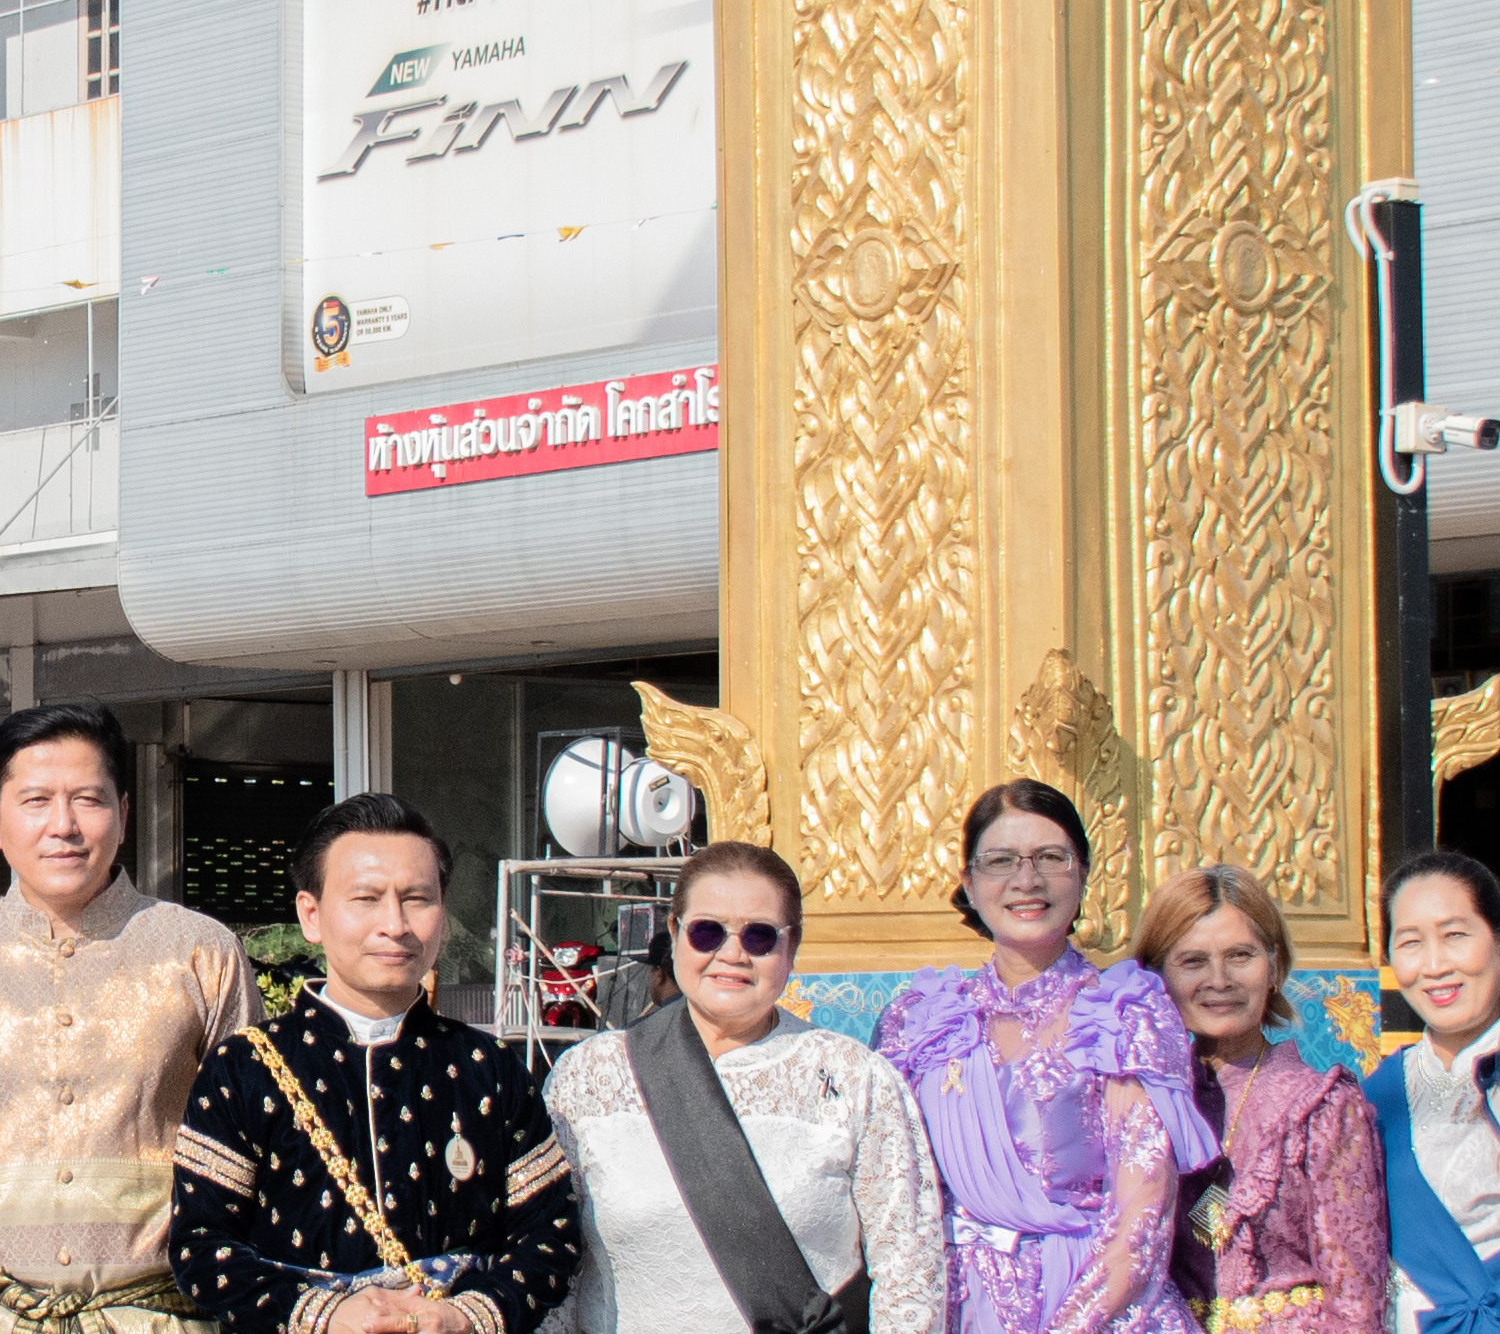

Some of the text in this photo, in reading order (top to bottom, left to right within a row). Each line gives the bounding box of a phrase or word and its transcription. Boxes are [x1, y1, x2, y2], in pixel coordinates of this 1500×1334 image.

[390, 37, 526, 86] NEW YAMAHA
[368, 395, 601, 480] ห้างหุ้นส่วนจำกัด
